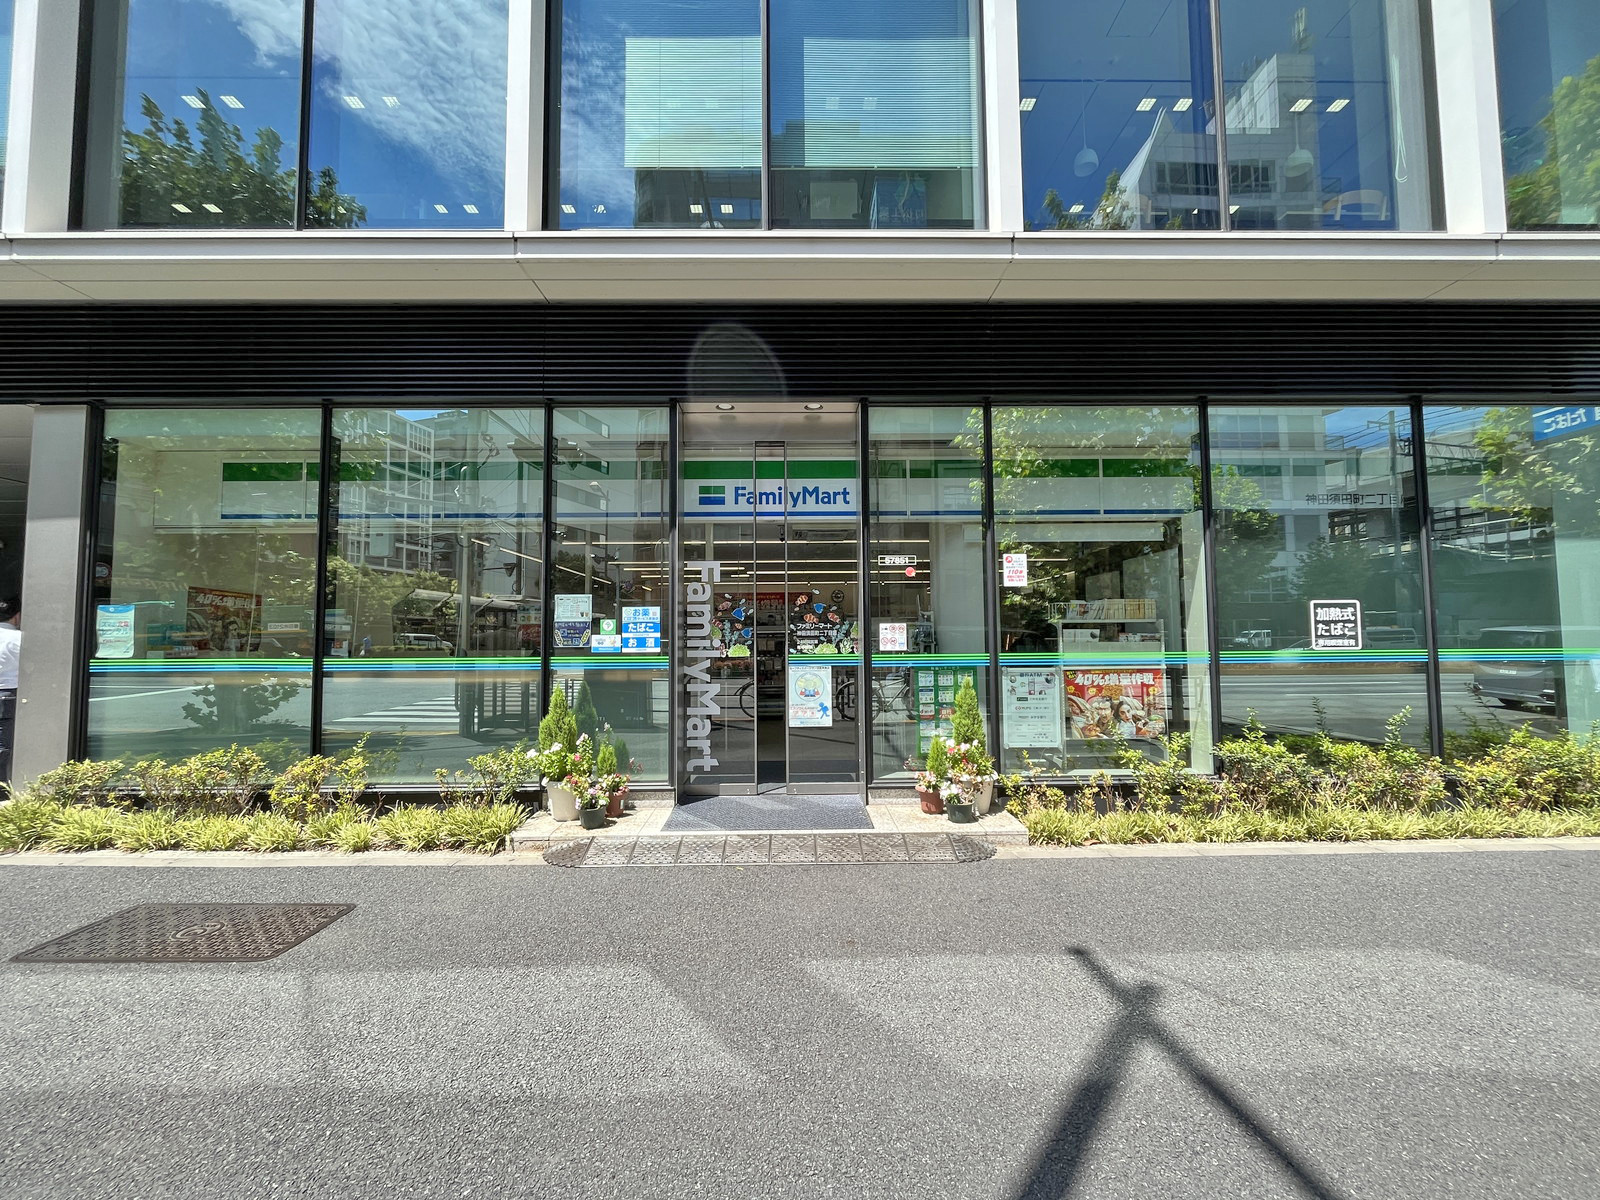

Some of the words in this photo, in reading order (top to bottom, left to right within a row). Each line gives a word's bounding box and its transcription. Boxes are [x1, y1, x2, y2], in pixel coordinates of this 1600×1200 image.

[1305, 493, 1404, 505] 神田須田町二丁目
[632, 608, 650, 617] お薬
[1316, 607, 1355, 621] 加熱式
[628, 623, 655, 632] たばこ
[1317, 623, 1356, 636] たばこ
[628, 638, 655, 648] お酒
[684, 560, 721, 772] FamilyMart
